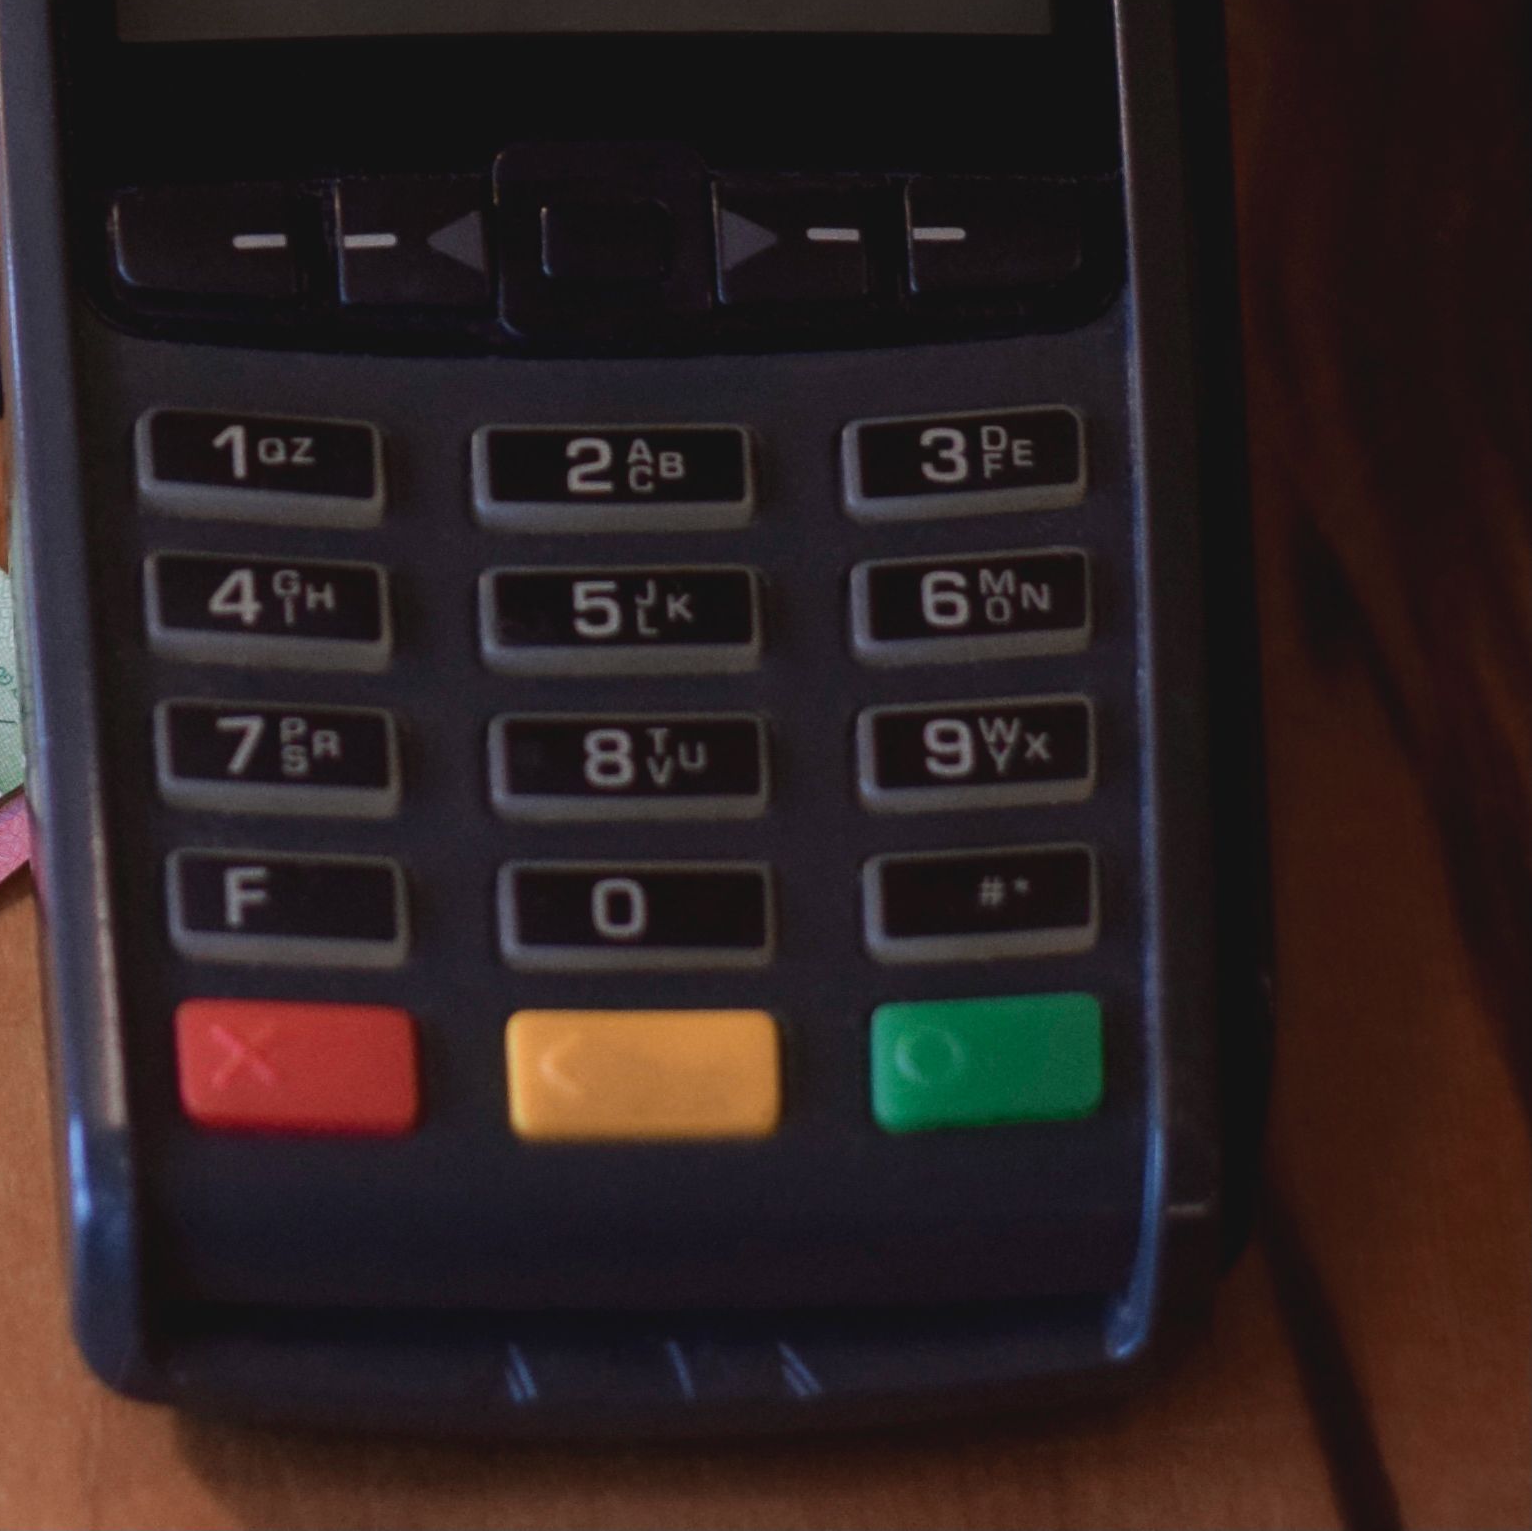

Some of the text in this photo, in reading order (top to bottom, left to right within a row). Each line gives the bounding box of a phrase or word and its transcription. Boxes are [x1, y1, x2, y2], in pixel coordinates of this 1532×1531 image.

[212, 424, 248, 480] 1
[565, 436, 614, 494] 2
[919, 426, 970, 484] 3
[207, 568, 263, 625] 4
[572, 580, 623, 638] 5
[920, 569, 971, 628] 6
[216, 714, 265, 775] 7
[583, 728, 636, 788] 8
[922, 718, 976, 778] 9
[223, 866, 267, 928] F
